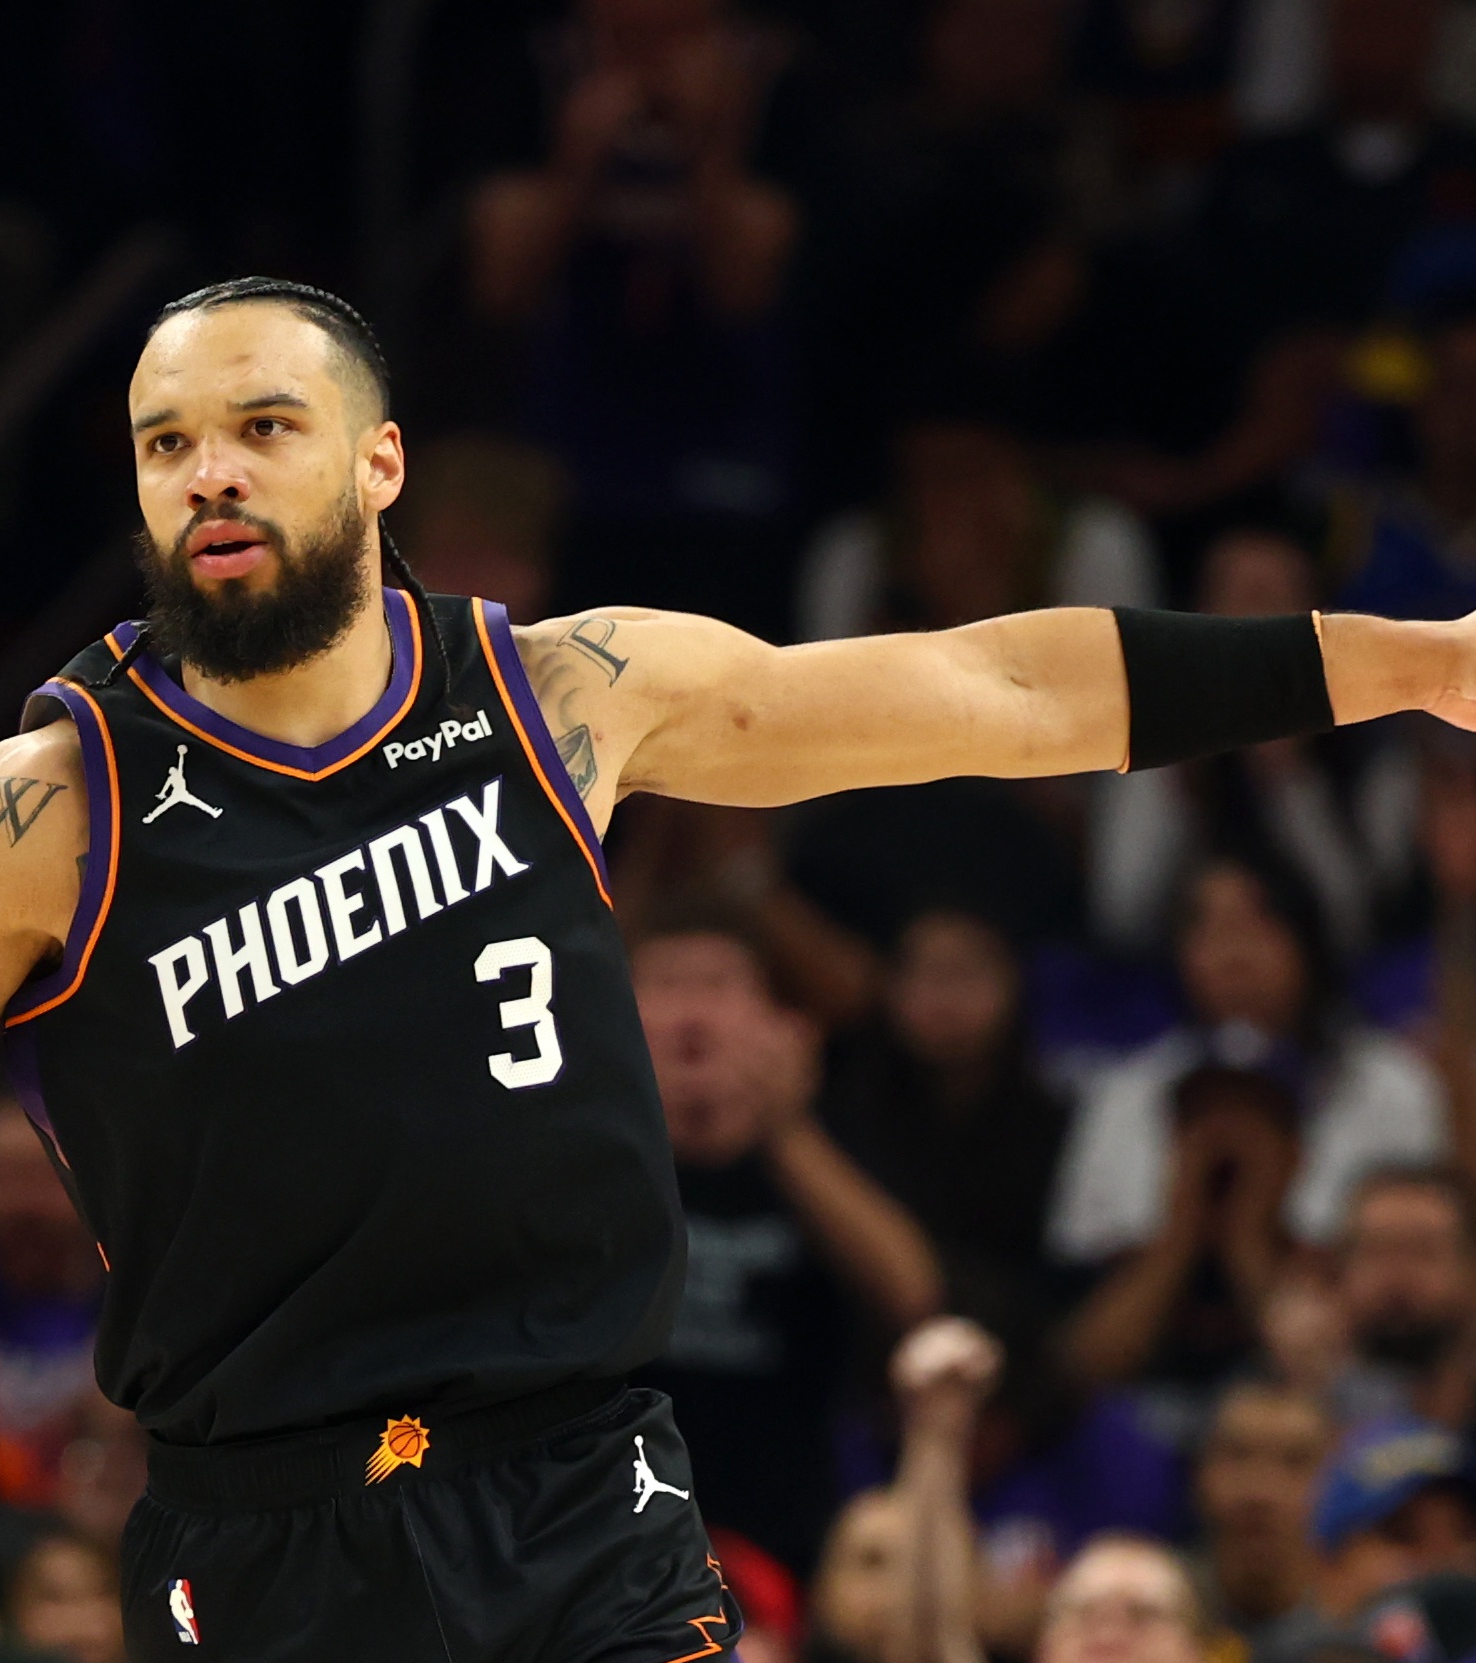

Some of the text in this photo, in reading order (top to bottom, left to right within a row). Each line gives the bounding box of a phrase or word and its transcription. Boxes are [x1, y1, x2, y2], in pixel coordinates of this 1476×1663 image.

[383, 709, 493, 769] PayPal
[147, 777, 531, 1051] PHOENIX
[474, 936, 564, 1091] 3
